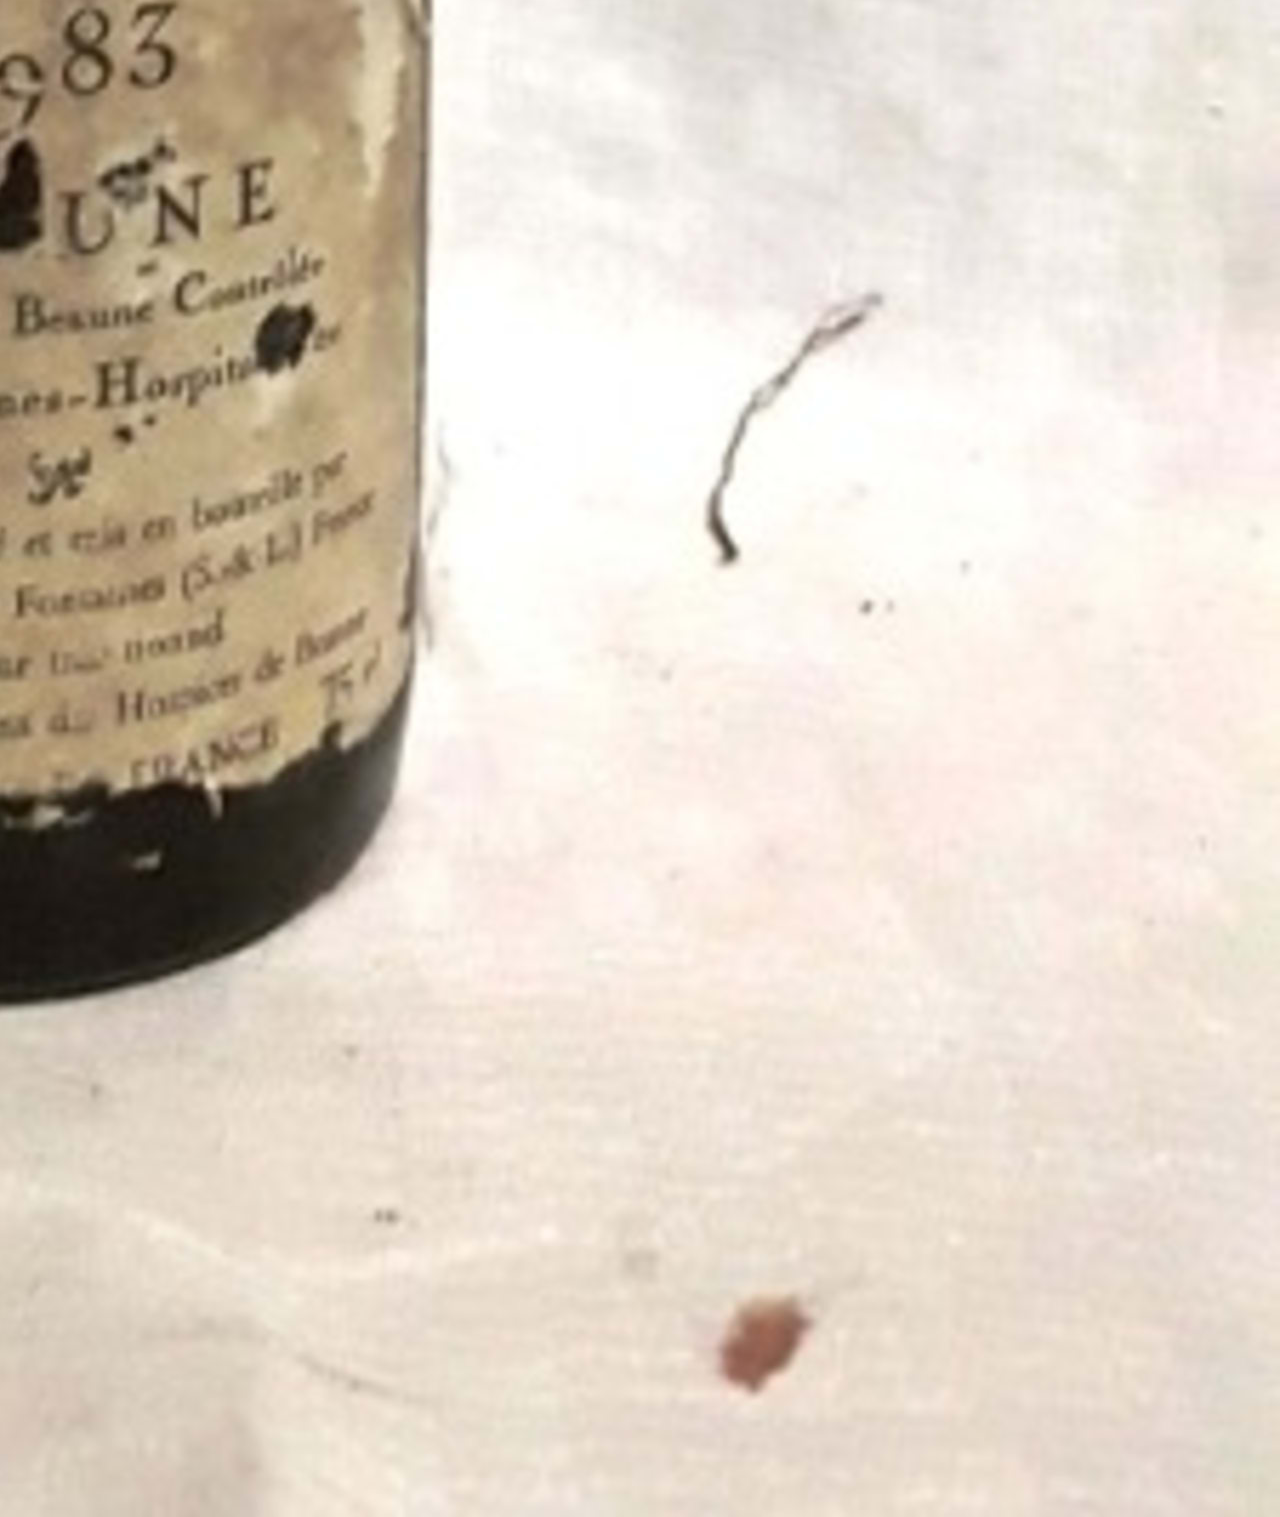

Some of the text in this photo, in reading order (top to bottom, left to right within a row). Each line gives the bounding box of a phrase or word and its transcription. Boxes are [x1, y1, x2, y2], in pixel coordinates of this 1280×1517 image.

[14, 289, 154, 338] Beaune
[24, 533, 53, 556] et
[141, 516, 177, 542] en
